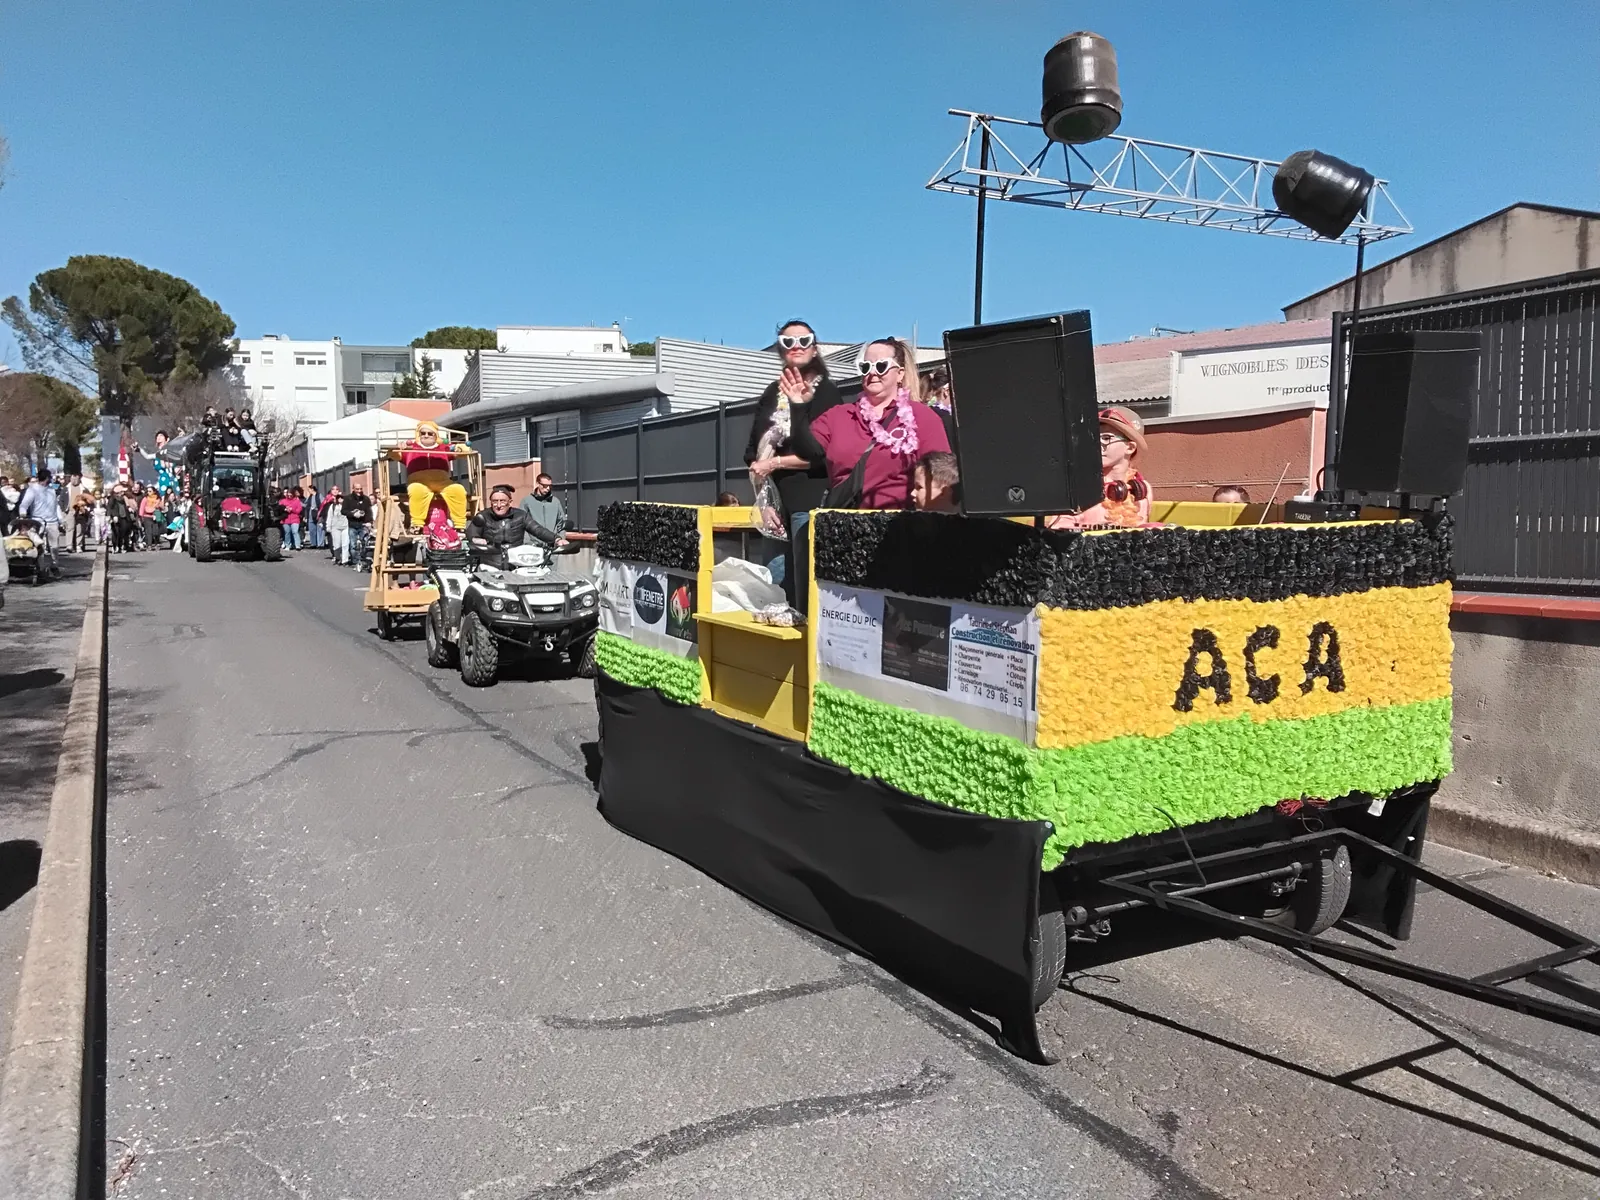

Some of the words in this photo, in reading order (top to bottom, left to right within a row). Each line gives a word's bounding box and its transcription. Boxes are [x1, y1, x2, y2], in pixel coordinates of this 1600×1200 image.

[1200, 359, 1288, 377] VIGNOBLES
[1296, 355, 1329, 370] DES
[852, 614, 862, 624] DU
[864, 616, 877, 628] PIC
[951, 627, 990, 641] Construction
[992, 635, 999, 644] et
[1170, 621, 1347, 712] ACA
[973, 685, 982, 696] 74
[986, 688, 996, 700] 29
[1013, 696, 1023, 708] 15
